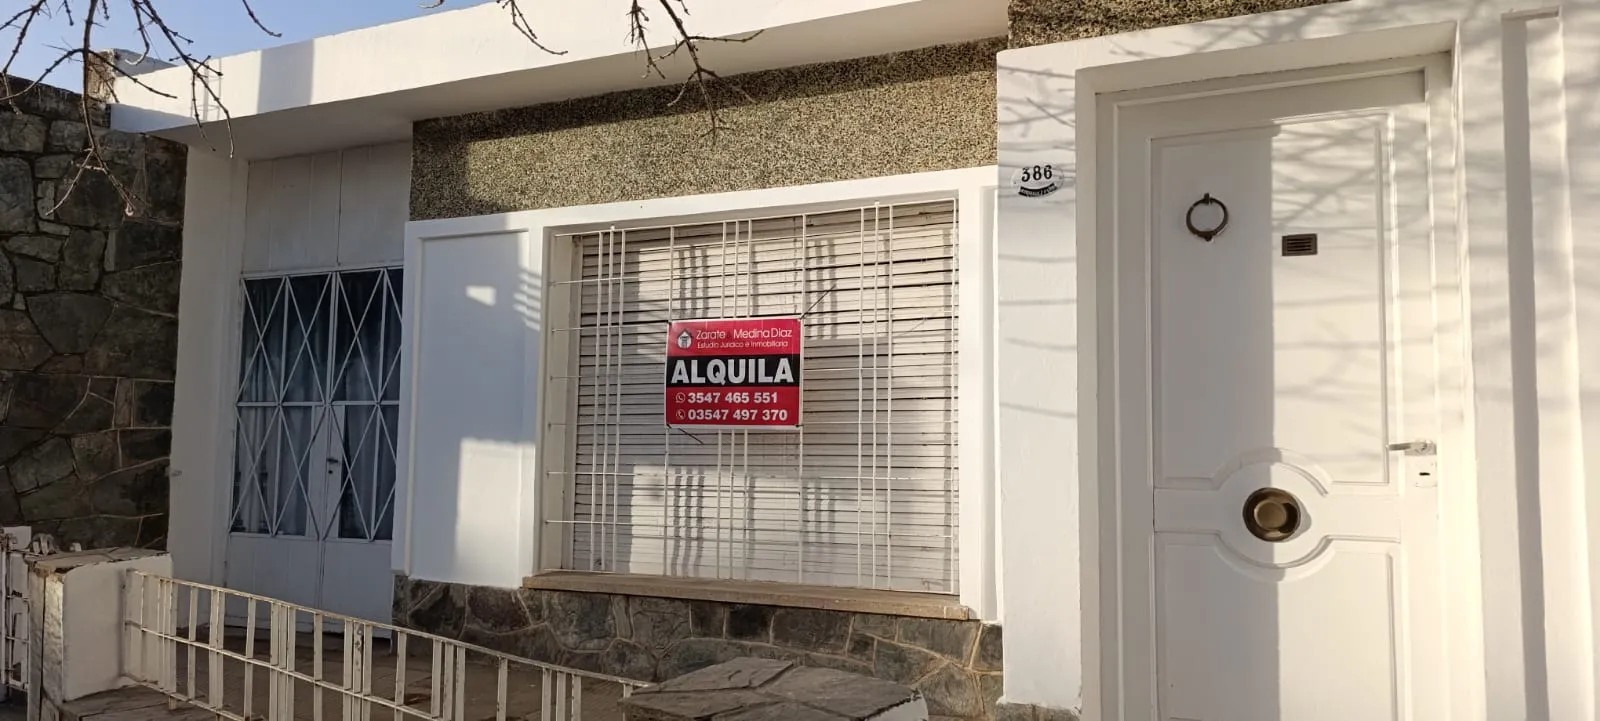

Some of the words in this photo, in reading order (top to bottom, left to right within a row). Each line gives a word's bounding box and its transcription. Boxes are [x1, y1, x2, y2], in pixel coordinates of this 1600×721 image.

[1021, 165, 1052, 182] 386
[733, 328, 771, 339] Medina
[750, 340, 788, 349] Inmobiliaria
[671, 357, 794, 386] ALQUILA
[687, 392, 720, 404] 3547
[725, 392, 750, 404] 465
[754, 391, 778, 403] 551
[687, 409, 729, 421] 03547
[732, 409, 758, 421] 497
[762, 409, 788, 421] 370
